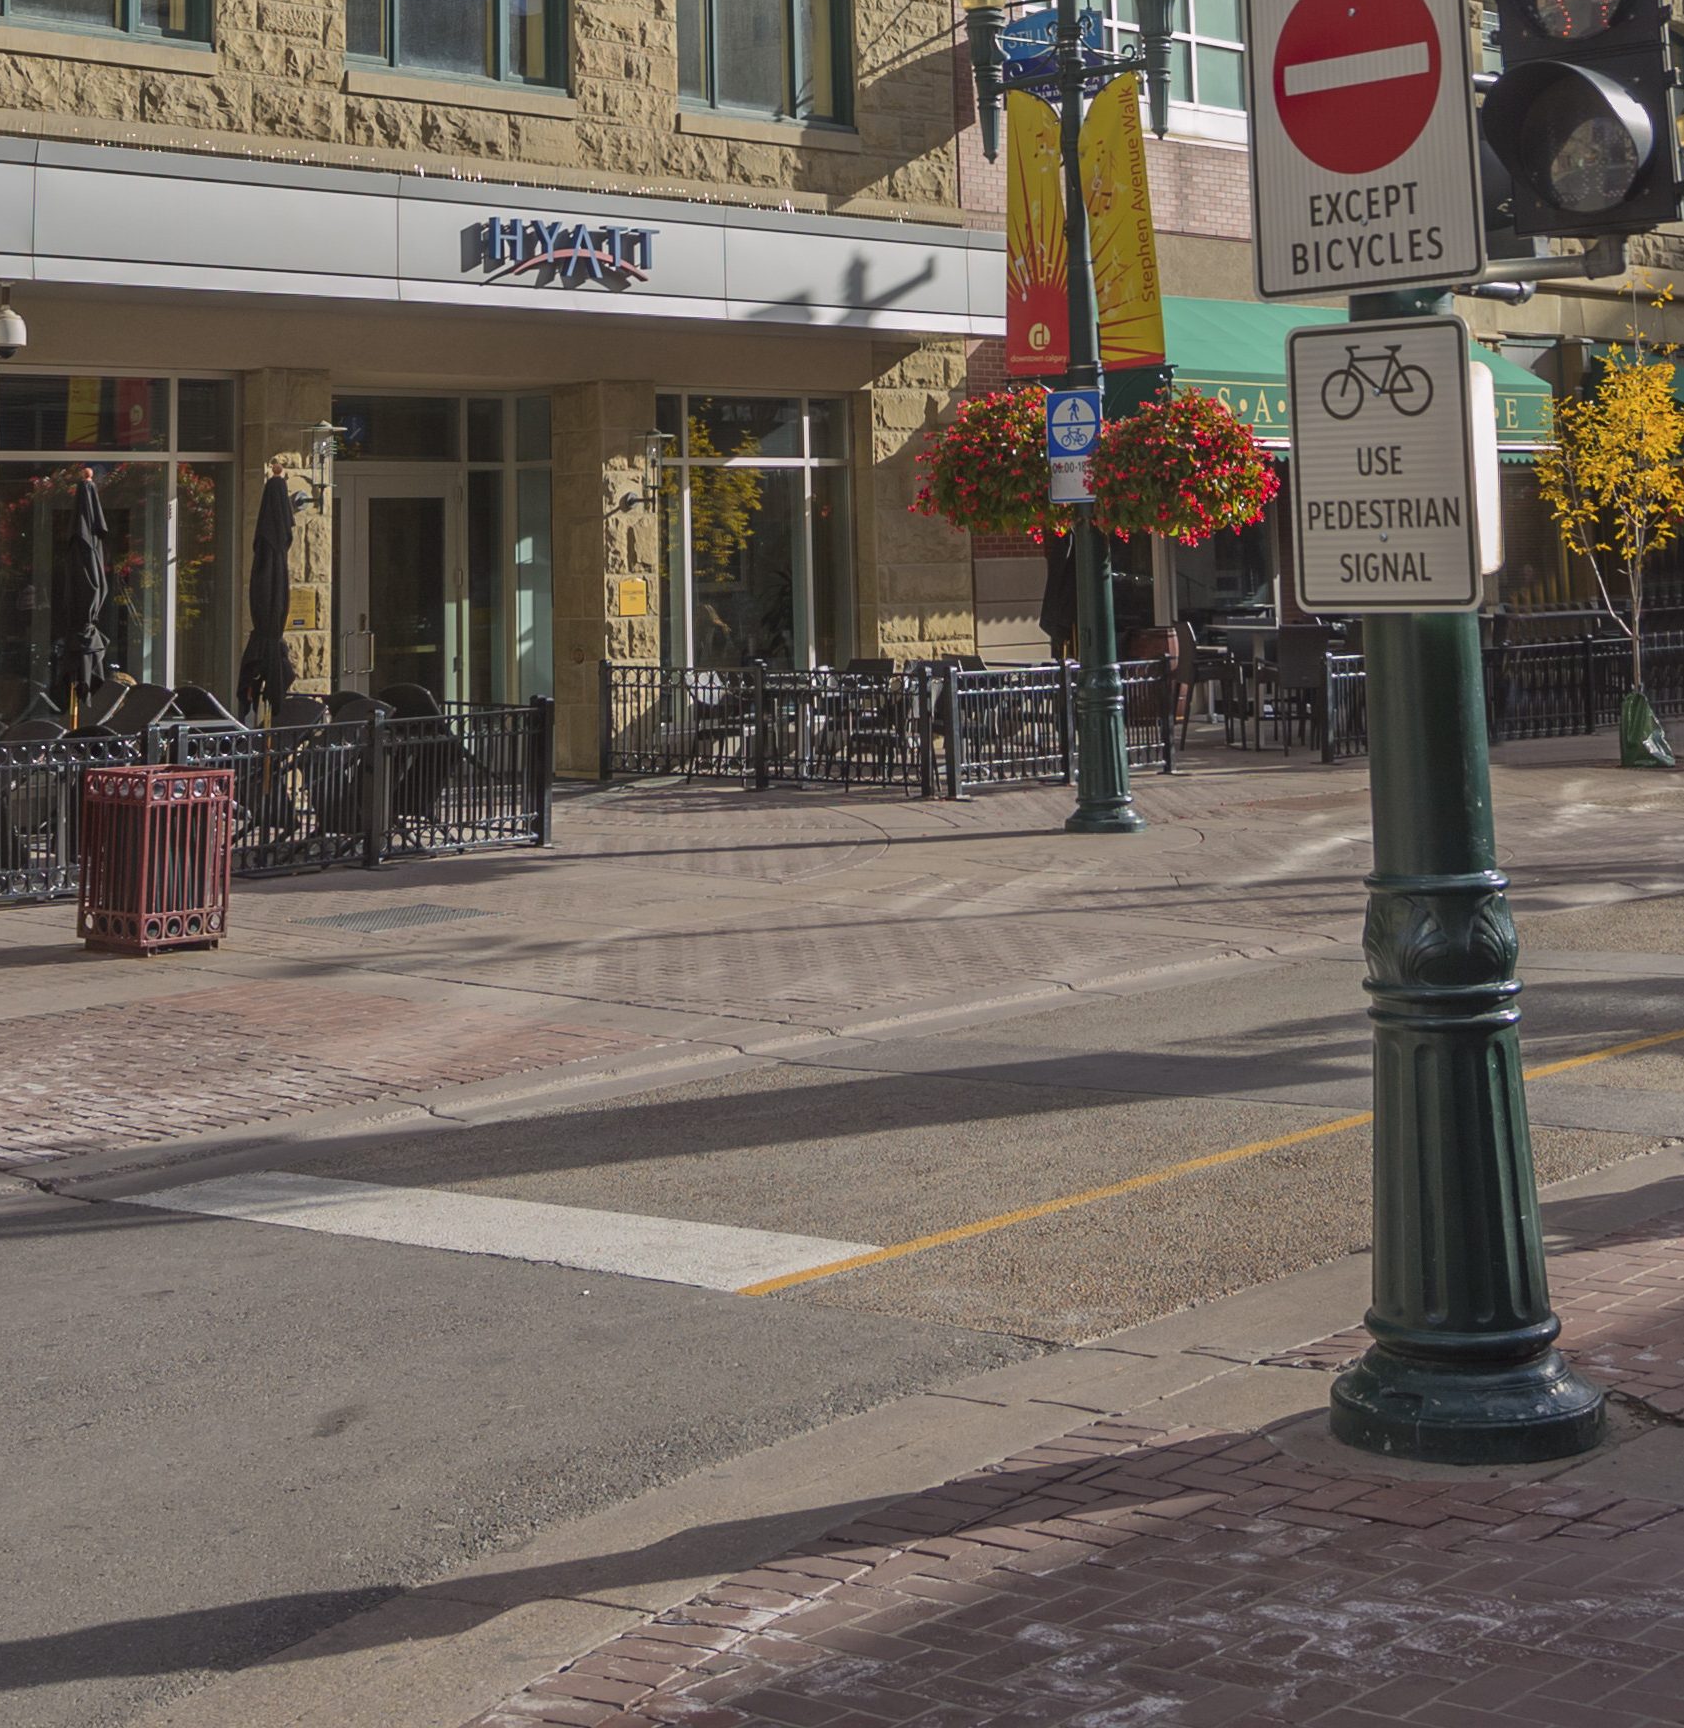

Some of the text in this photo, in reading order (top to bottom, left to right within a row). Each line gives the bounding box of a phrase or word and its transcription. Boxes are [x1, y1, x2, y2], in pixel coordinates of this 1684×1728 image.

[1118, 84, 1157, 303] Stephen Avenue Walk
[1308, 181, 1418, 227] EXCEPT
[488, 216, 660, 279] HYATT
[1291, 226, 1444, 276] BICYCLES
[1356, 445, 1404, 477] USE
[1307, 496, 1461, 531] PEDESTRIAN
[1340, 552, 1433, 584] SIGNAL
